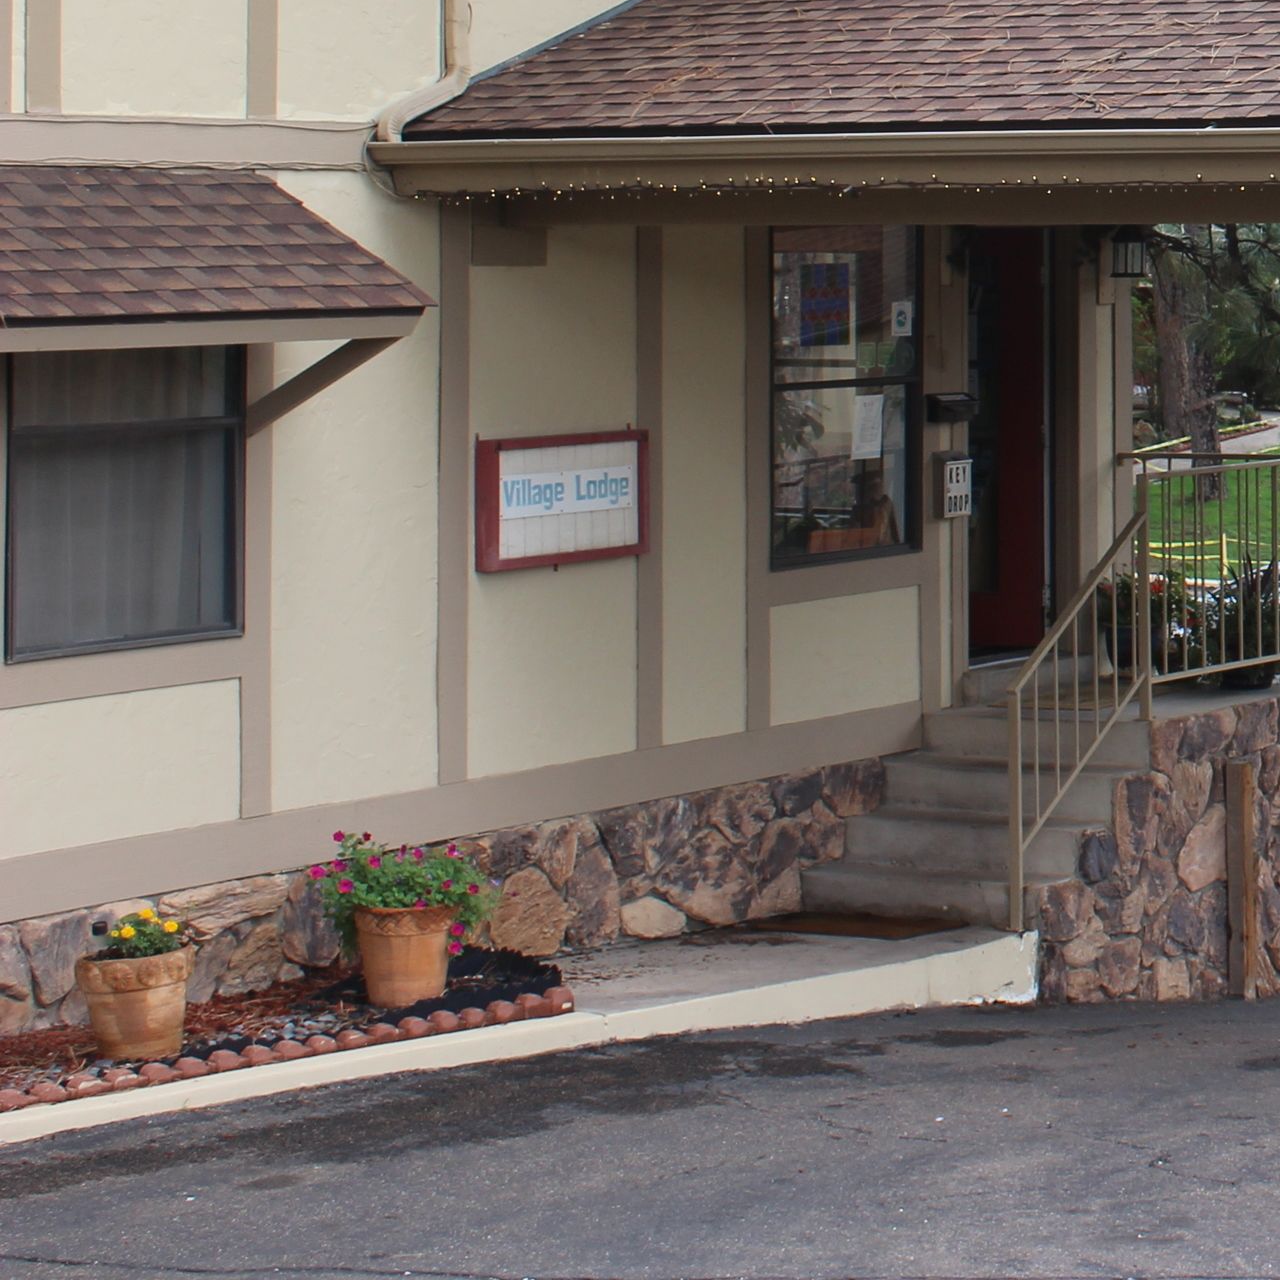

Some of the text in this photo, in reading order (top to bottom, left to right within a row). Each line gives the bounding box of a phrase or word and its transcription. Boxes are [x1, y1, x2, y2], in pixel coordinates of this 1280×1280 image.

[948, 465, 967, 484] KEY
[503, 472, 629, 510] Village Lodge
[948, 494, 969, 513] DROP
